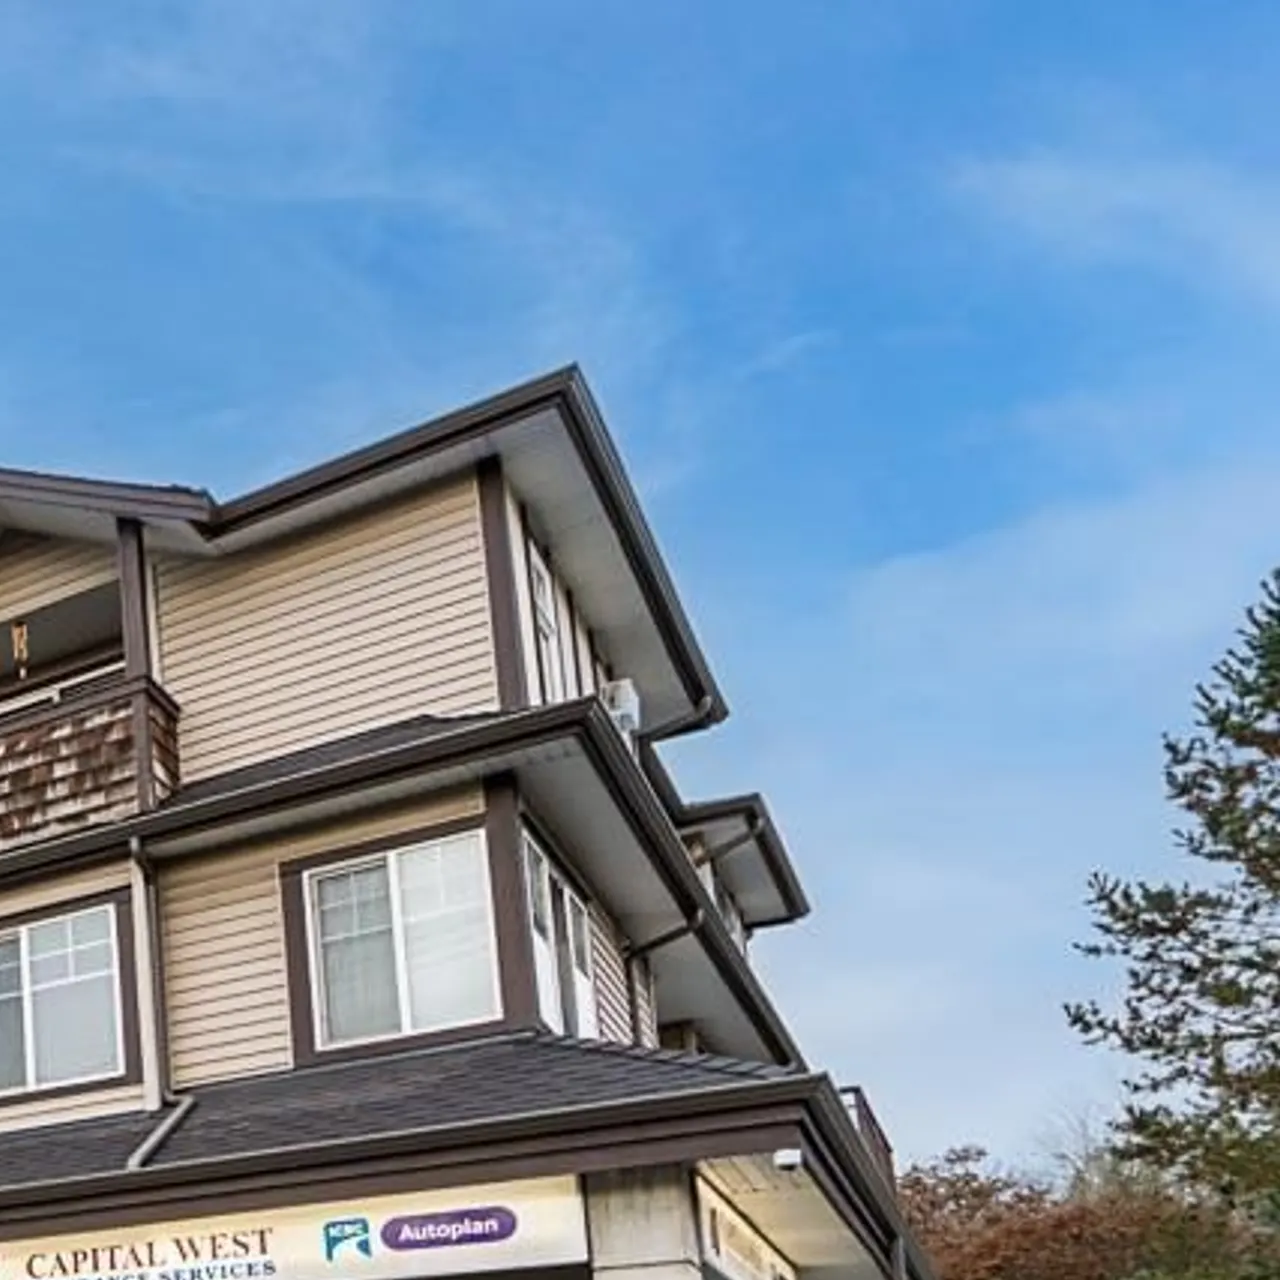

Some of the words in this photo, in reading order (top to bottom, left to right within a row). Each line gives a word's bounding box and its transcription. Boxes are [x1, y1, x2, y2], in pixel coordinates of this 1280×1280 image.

[397, 1217, 499, 1242] Autoplan
[26, 1241, 166, 1279] CAPITAL
[172, 1228, 273, 1262] WEST
